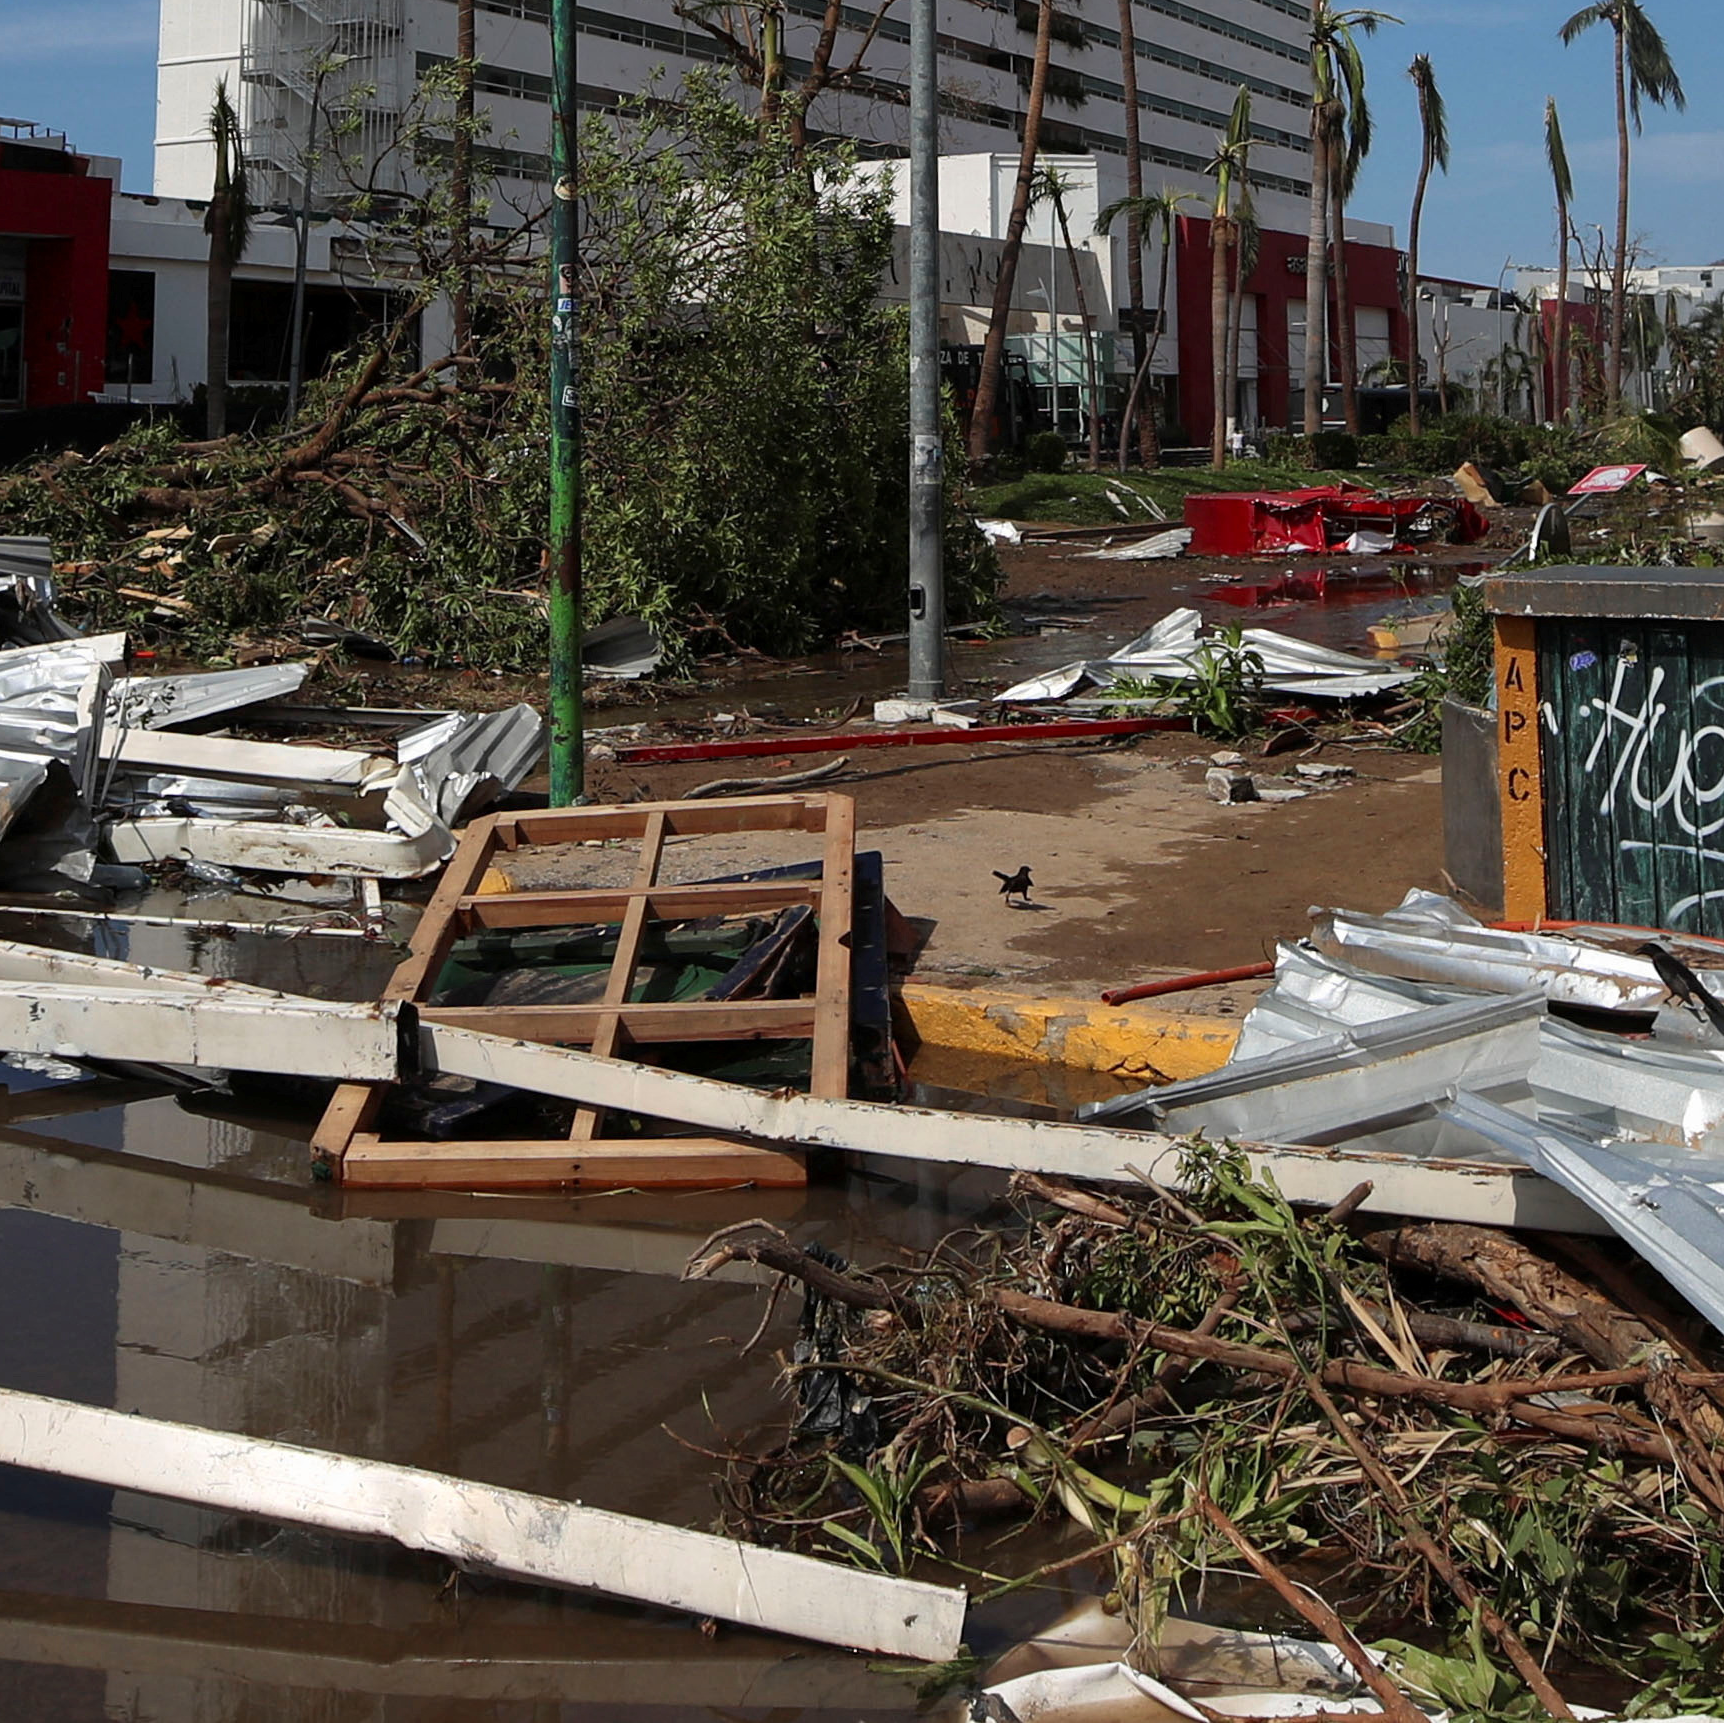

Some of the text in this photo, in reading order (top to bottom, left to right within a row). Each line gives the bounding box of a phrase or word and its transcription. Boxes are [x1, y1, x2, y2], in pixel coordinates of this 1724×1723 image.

[940, 351, 952, 364] ZA
[958, 351, 969, 365] DE
[1504, 657, 1530, 801] APC
